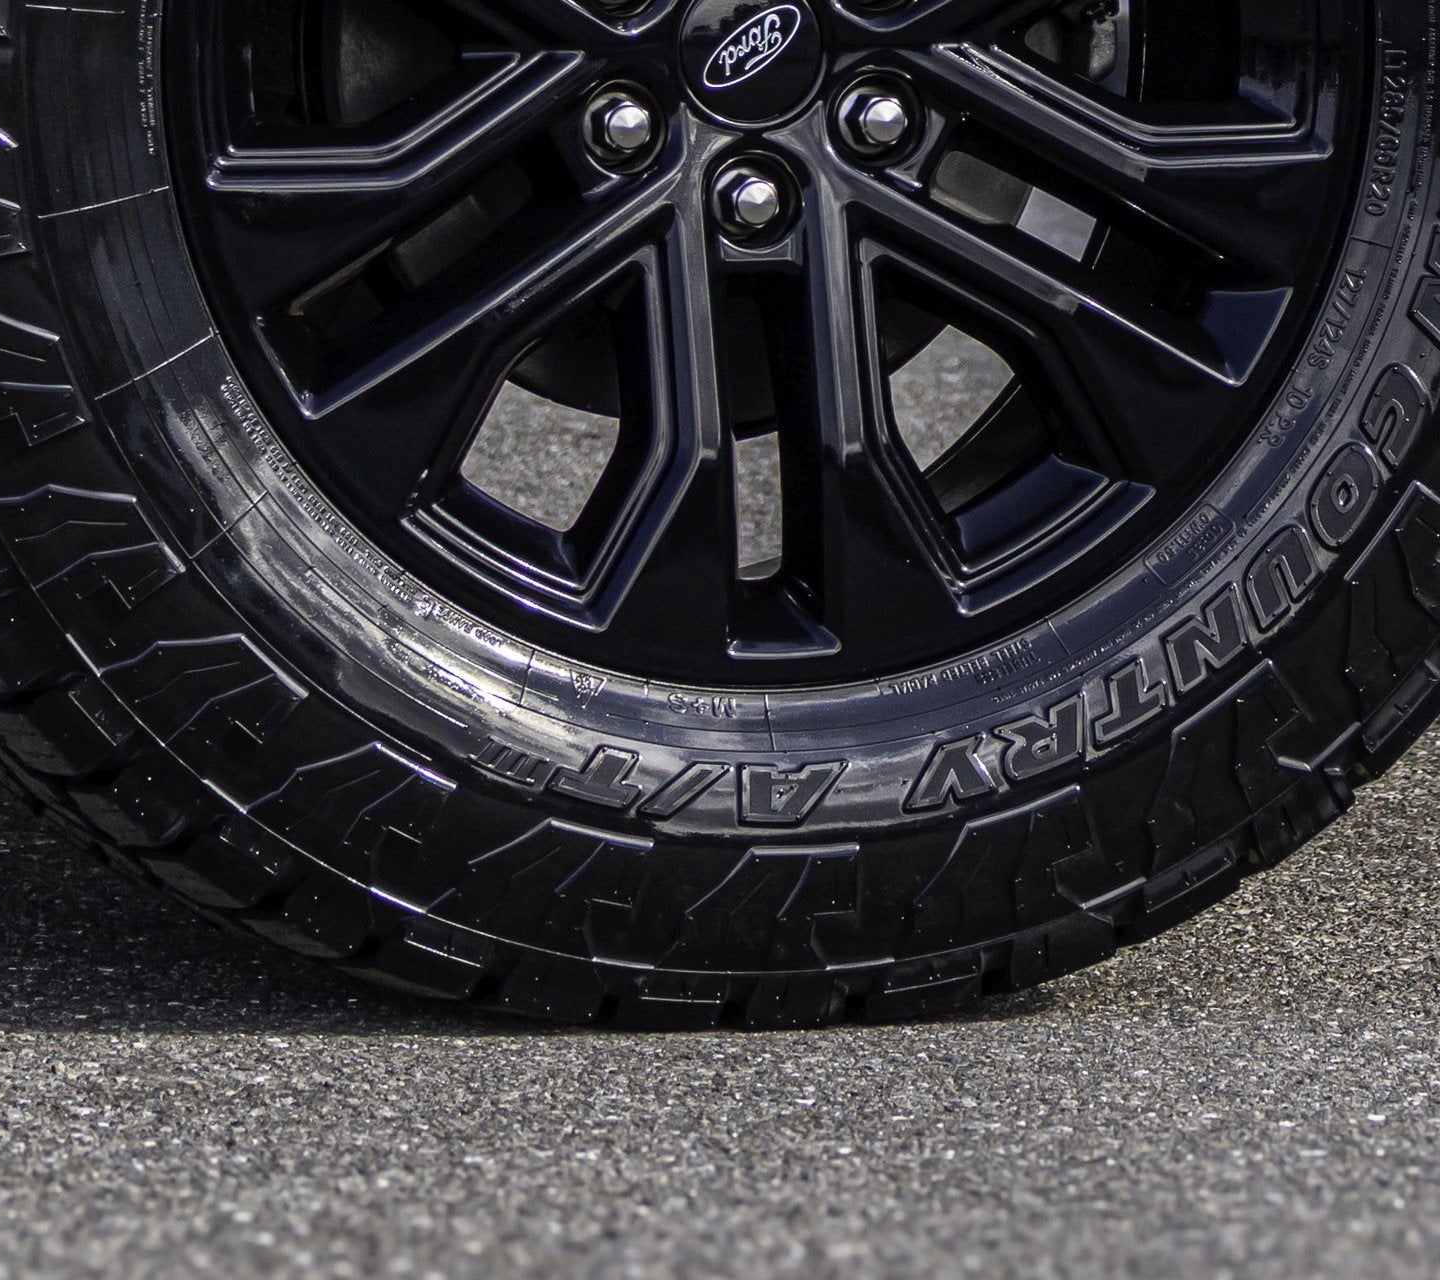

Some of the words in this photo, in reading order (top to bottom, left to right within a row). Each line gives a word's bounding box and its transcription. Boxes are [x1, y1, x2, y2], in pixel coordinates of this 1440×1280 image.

[717, 13, 783, 77] Ford
[904, 364, 1436, 812] COUNTRY
[664, 690, 738, 723] M+S
